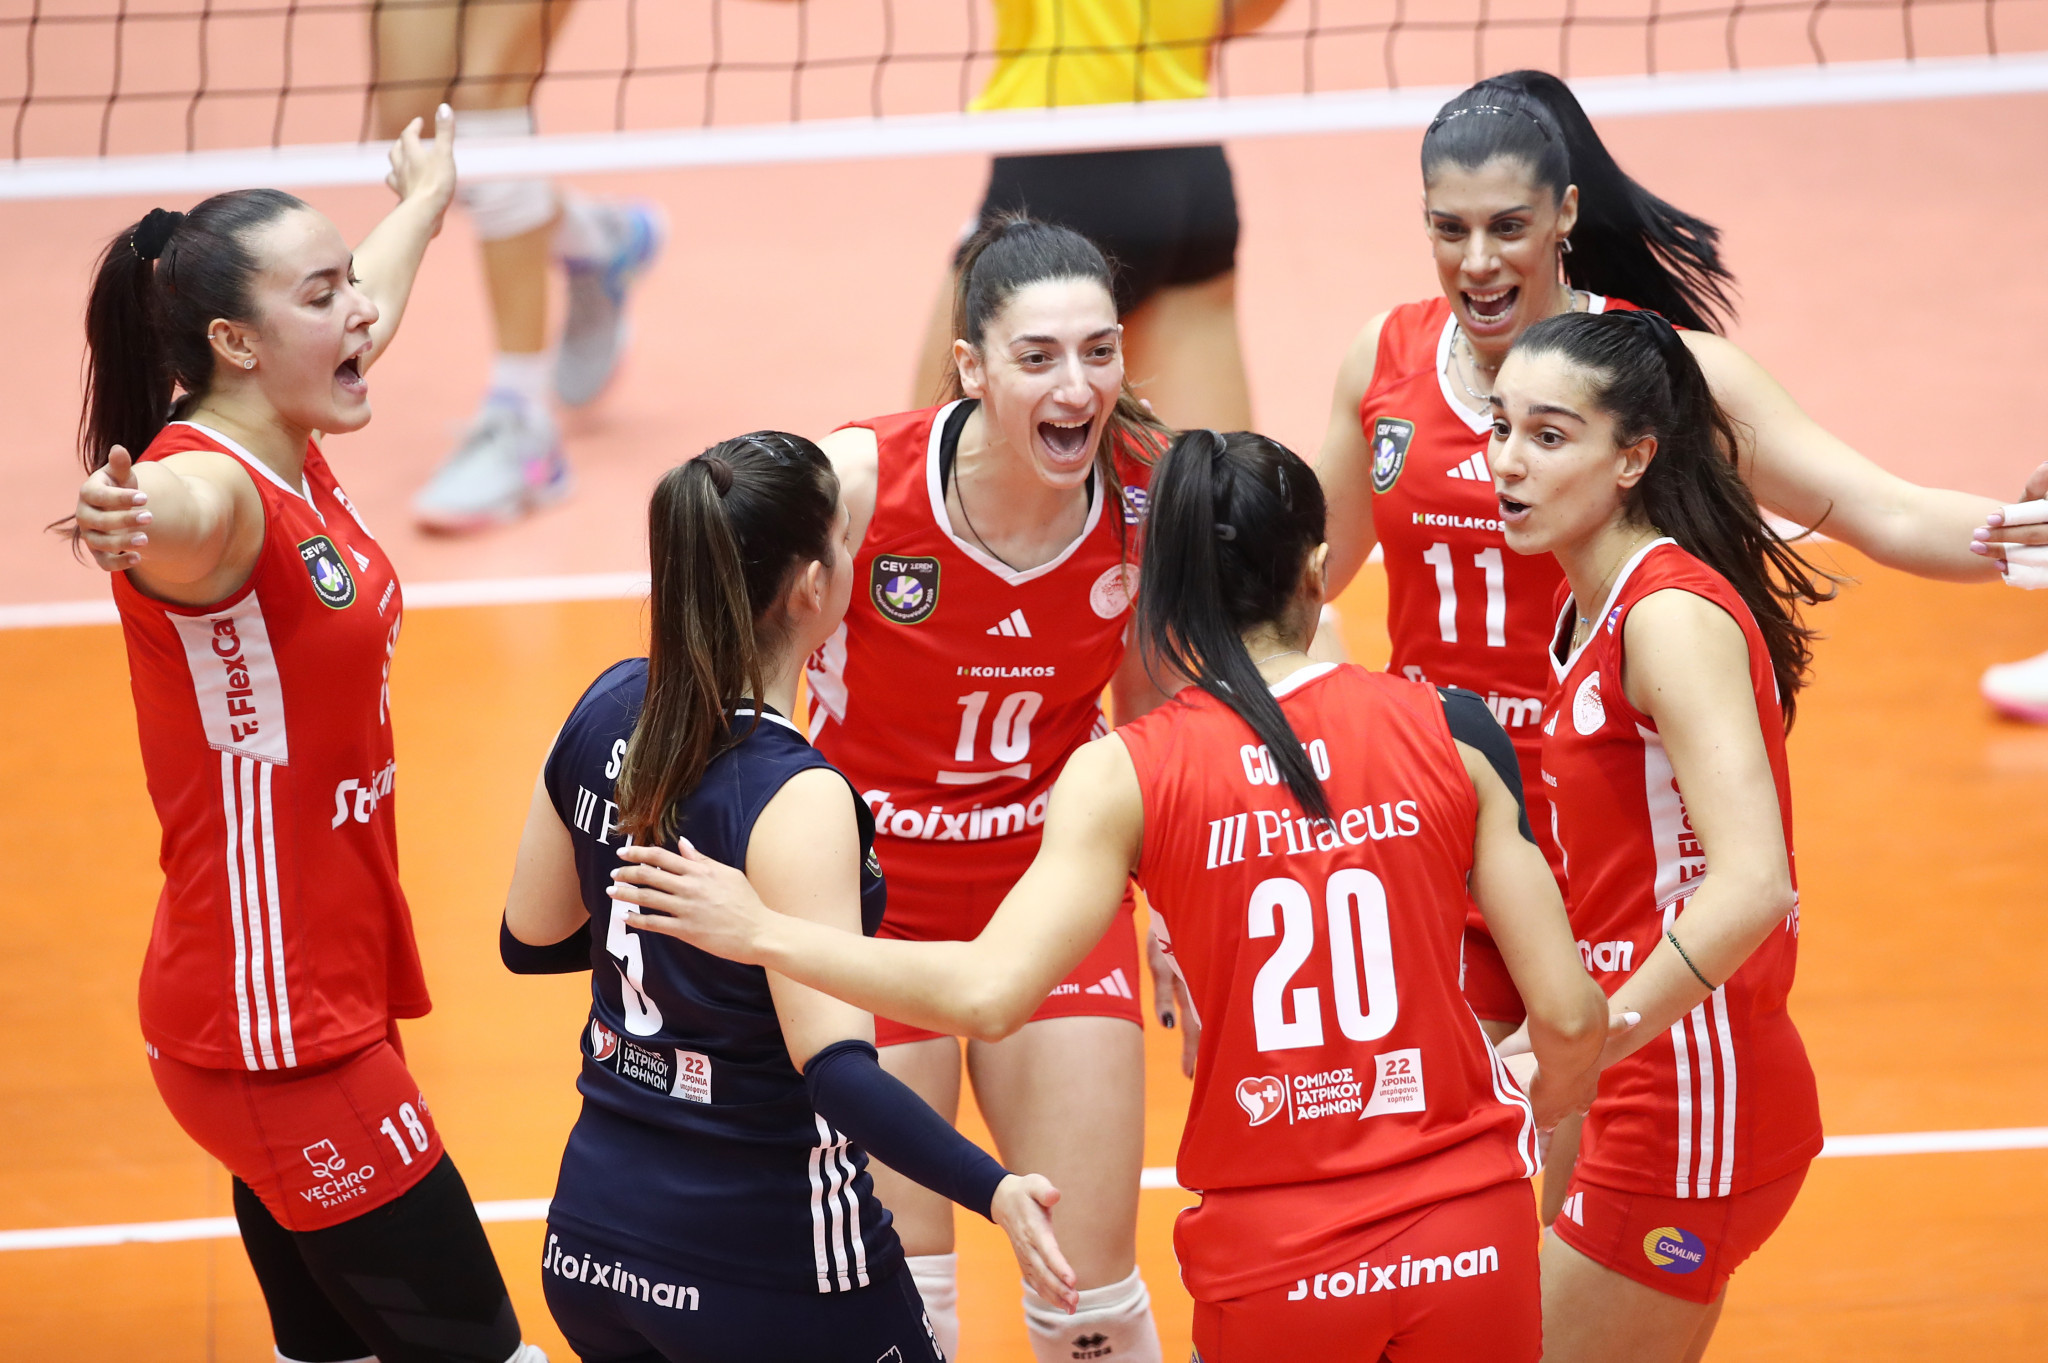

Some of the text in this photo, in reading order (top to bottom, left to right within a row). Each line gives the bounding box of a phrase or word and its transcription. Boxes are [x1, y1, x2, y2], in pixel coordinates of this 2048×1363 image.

[1425, 513, 1506, 532] KOILAKOS
[301, 543, 321, 561] CEV
[880, 560, 908, 573] CEV
[1422, 542, 1507, 647] 11
[211, 616, 257, 717] FlexCa
[970, 666, 1055, 678] KOILAKOS
[955, 690, 1043, 763] 10
[604, 738, 627, 780] S
[1253, 800, 1420, 857] Piraeus
[1247, 868, 1399, 1052] 20
[685, 1056, 704, 1075] 22
[1385, 1058, 1411, 1077] 22
[380, 1102, 430, 1166] 18
[300, 1165, 375, 1203] VECHRO
[321, 1185, 367, 1209] PAINTS
[1659, 1241, 1702, 1264] COMLINE
[543, 1233, 700, 1311] Stoiximan
